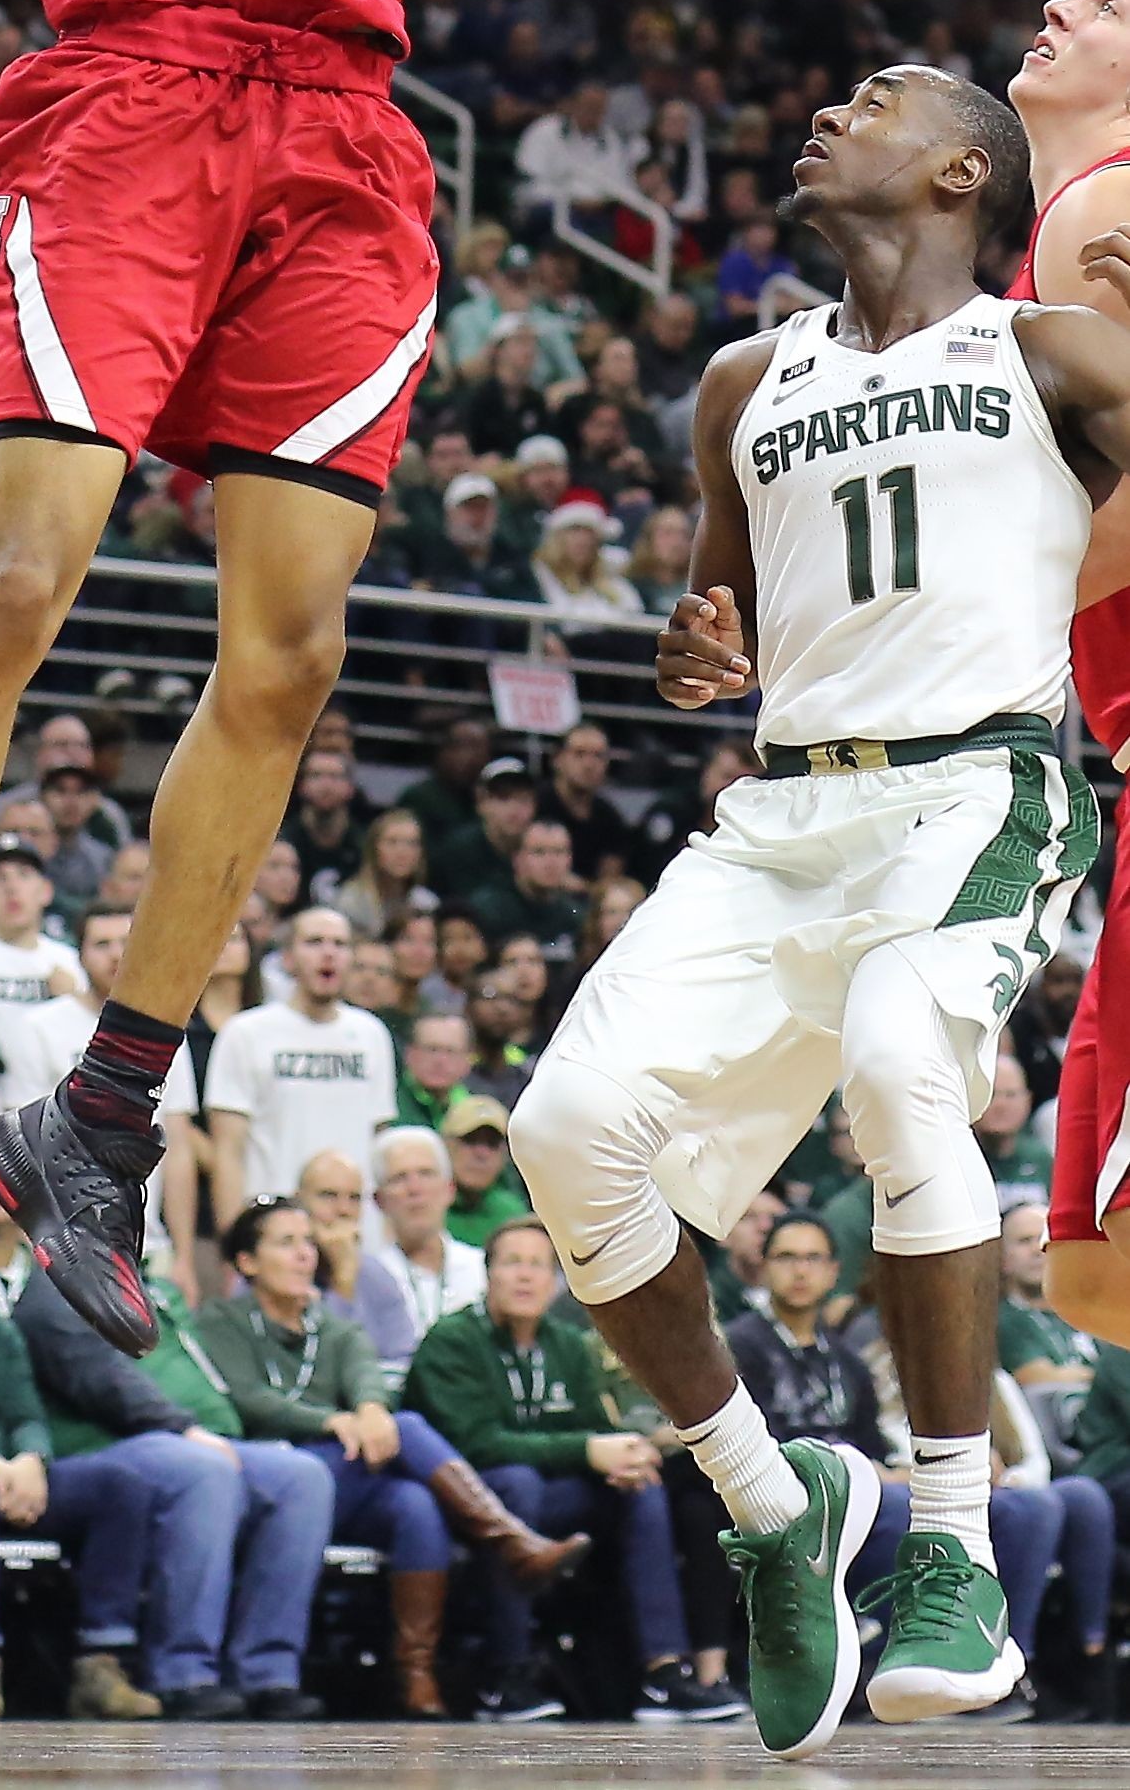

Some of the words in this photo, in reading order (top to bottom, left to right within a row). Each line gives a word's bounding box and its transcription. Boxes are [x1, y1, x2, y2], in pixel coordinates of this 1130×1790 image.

[785, 360, 810, 380] JUD
[751, 383, 1012, 486] SPARTANS
[831, 463, 921, 606] 11
